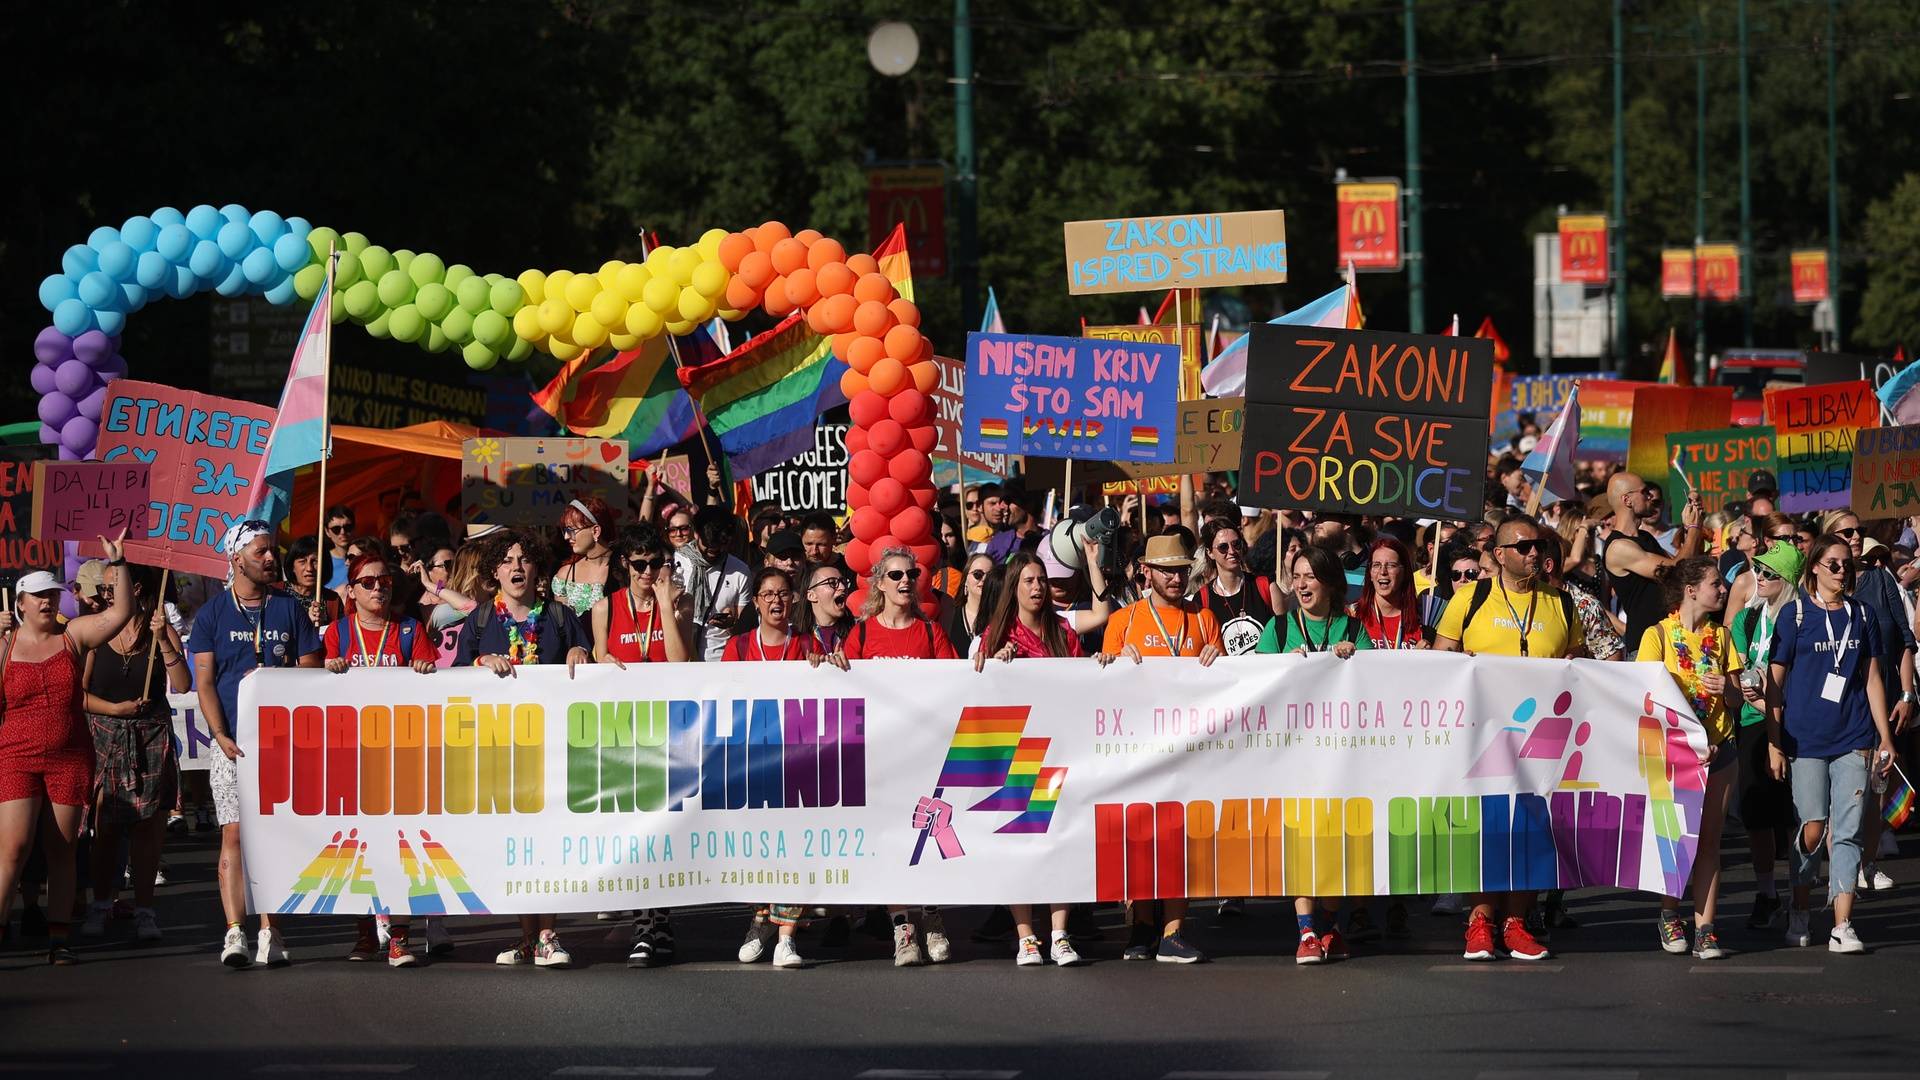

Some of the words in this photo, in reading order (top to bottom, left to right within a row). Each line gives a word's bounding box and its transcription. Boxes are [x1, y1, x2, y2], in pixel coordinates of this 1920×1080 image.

[1105, 216, 1223, 250] ZAKONI
[1073, 251, 1171, 287] ISPRED
[1181, 241, 1287, 279] STRANKE
[334, 363, 371, 395] NIKO
[979, 339, 1077, 380] NISAM
[1092, 347, 1162, 384] KRIV
[1289, 340, 1468, 403] ZAKONI
[1005, 376, 1071, 415] ŠTO
[1083, 385, 1144, 420] SAM
[1786, 391, 1863, 428] LJUBAV
[106, 396, 271, 455] ЕТИКЕТЕ
[1288, 407, 1353, 455] ZA
[1370, 416, 1452, 466] SVE
[1686, 443, 1720, 463] TU
[1724, 436, 1772, 463] SMO
[53, 470, 84, 494] DA
[97, 469, 116, 490] LI
[126, 469, 148, 490] BI
[192, 457, 250, 496] ЗА
[752, 469, 847, 511] WELCOME!
[1255, 451, 1471, 514] PORODICE
[54, 508, 85, 534] NE
[109, 503, 147, 532] BI?
[87, 493, 110, 510] ILI
[1813, 639, 1861, 653] ПАРТЕР
[1095, 708, 1134, 737] ВХ.
[1154, 705, 1268, 737] ПОВОРКА
[1287, 701, 1385, 730] ПОНОСА
[1403, 700, 1475, 728] 2022.
[258, 697, 545, 816] PORODIČNO
[567, 698, 866, 814] OKUPLJANJE
[1186, 738, 1234, 752] шетња
[1245, 732, 1304, 748] ЛГБТИ+
[1315, 733, 1397, 750] заједнице
[1407, 734, 1414, 749] у
[1424, 730, 1452, 746] БиХ
[506, 836, 545, 866] BH.
[562, 831, 674, 866] POVORKA
[690, 830, 788, 860] PONOSA
[804, 828, 875, 858] 2022.
[1095, 796, 1374, 902] ПОРОДИЧНО
[506, 878, 589, 896] protestna
[598, 875, 650, 893] šetnja
[659, 870, 711, 889] LGBTI+
[720, 869, 800, 886] zajednice
[809, 872, 816, 885] u
[825, 868, 849, 884] BiH
